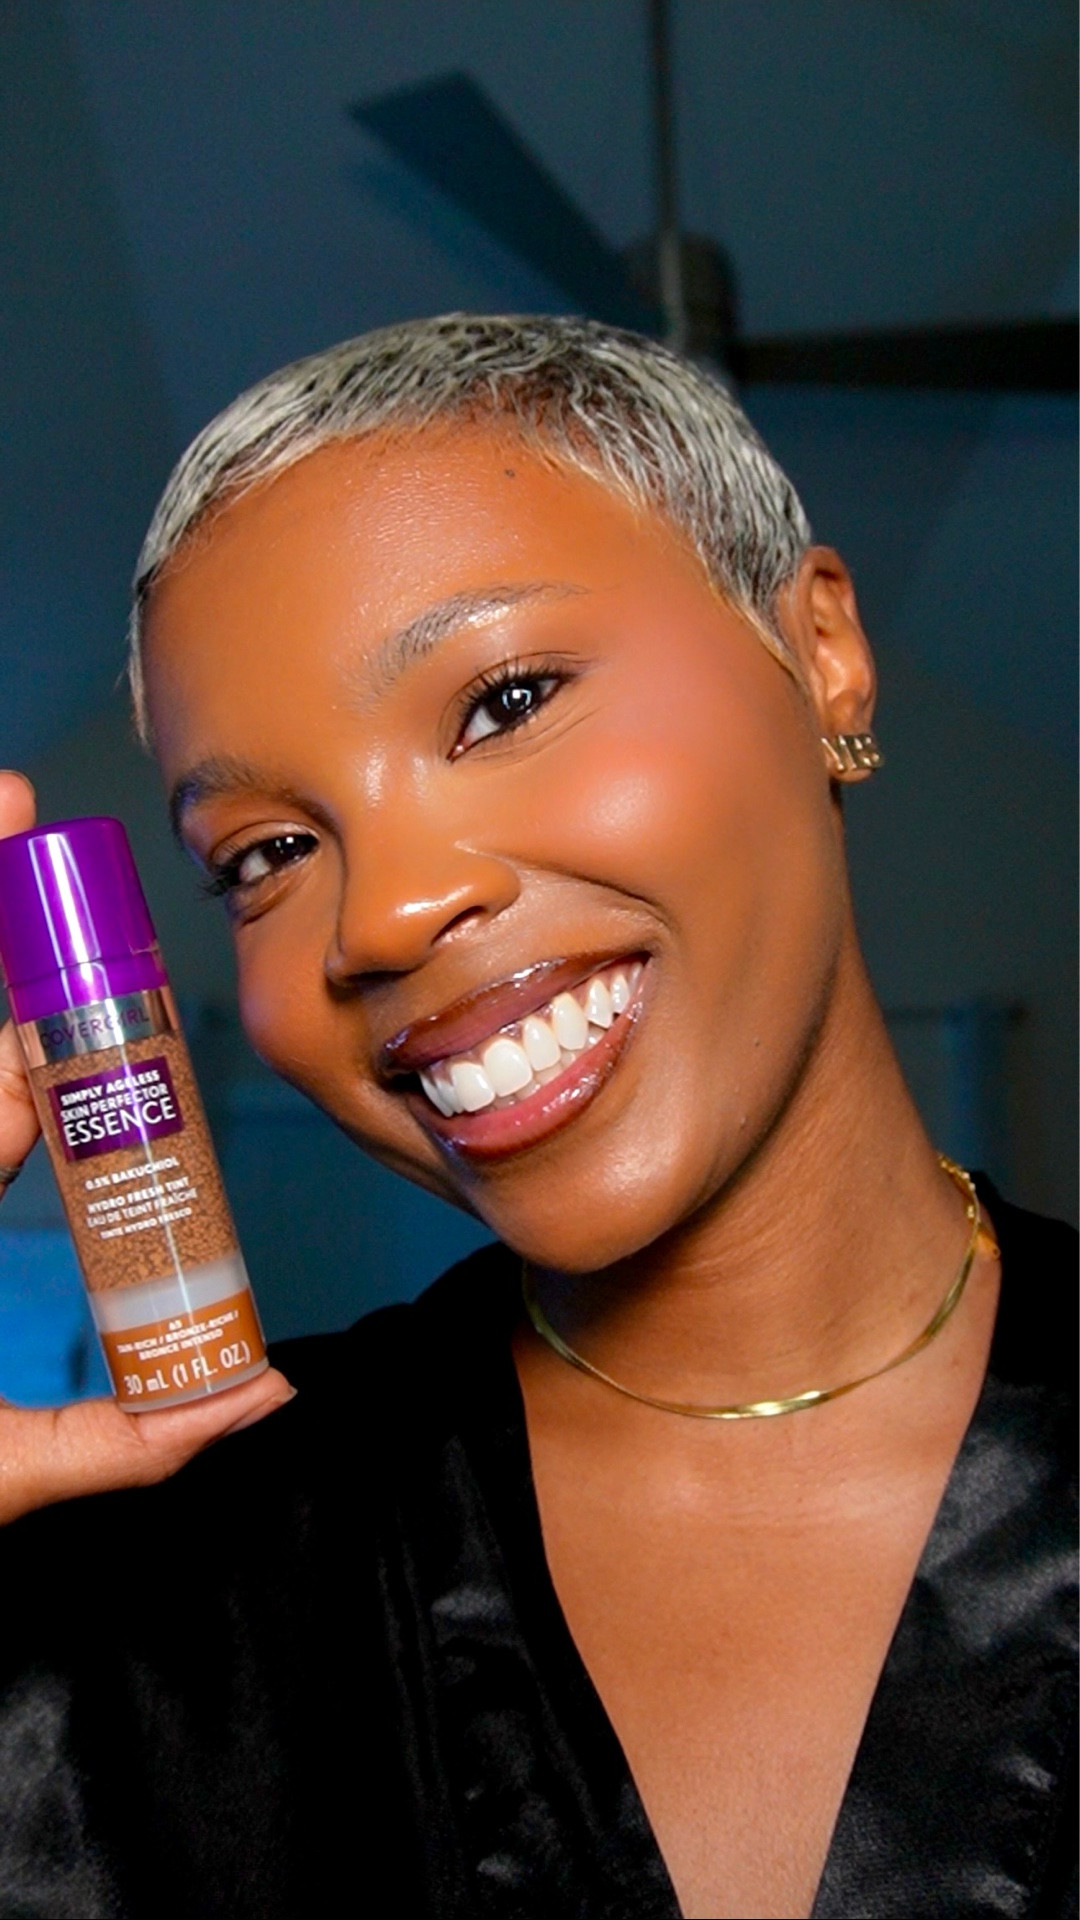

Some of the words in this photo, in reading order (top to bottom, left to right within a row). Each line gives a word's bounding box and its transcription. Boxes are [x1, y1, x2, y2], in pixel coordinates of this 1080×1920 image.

[61, 1085, 102, 1106] SIMPLY
[106, 1070, 160, 1094] AGELESS
[61, 1104, 90, 1122] SKIN
[90, 1083, 169, 1114] PERFECTOR
[63, 1096, 176, 1147] ESSENCE
[111, 1156, 179, 1184] BAKUCHIOL
[87, 1196, 126, 1214] HYDRO
[126, 1184, 165, 1203] FRESH
[165, 1176, 189, 1191] TINT
[87, 1215, 106, 1228] EAU
[106, 1210, 121, 1223] DE
[121, 1201, 152, 1219] TEINT
[124, 1374, 143, 1395] 30
[146, 1369, 169, 1392] mL
[172, 1363, 189, 1388] (1
[191, 1356, 218, 1380] FL.
